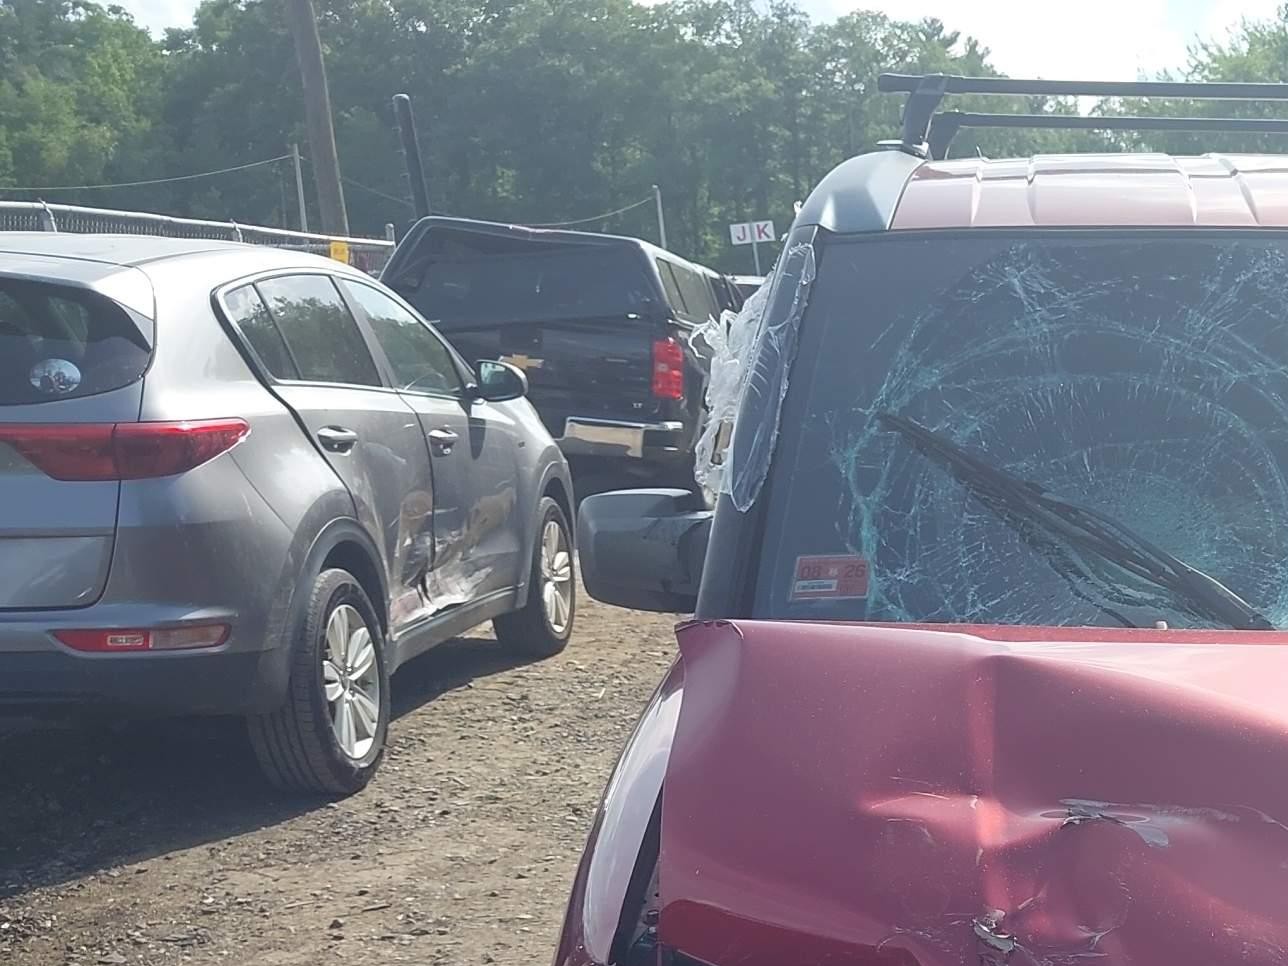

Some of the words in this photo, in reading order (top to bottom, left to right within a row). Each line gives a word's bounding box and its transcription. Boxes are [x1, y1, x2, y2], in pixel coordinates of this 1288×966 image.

[736, 226, 747, 242] J
[756, 223, 771, 240] K
[844, 563, 866, 578] 26
